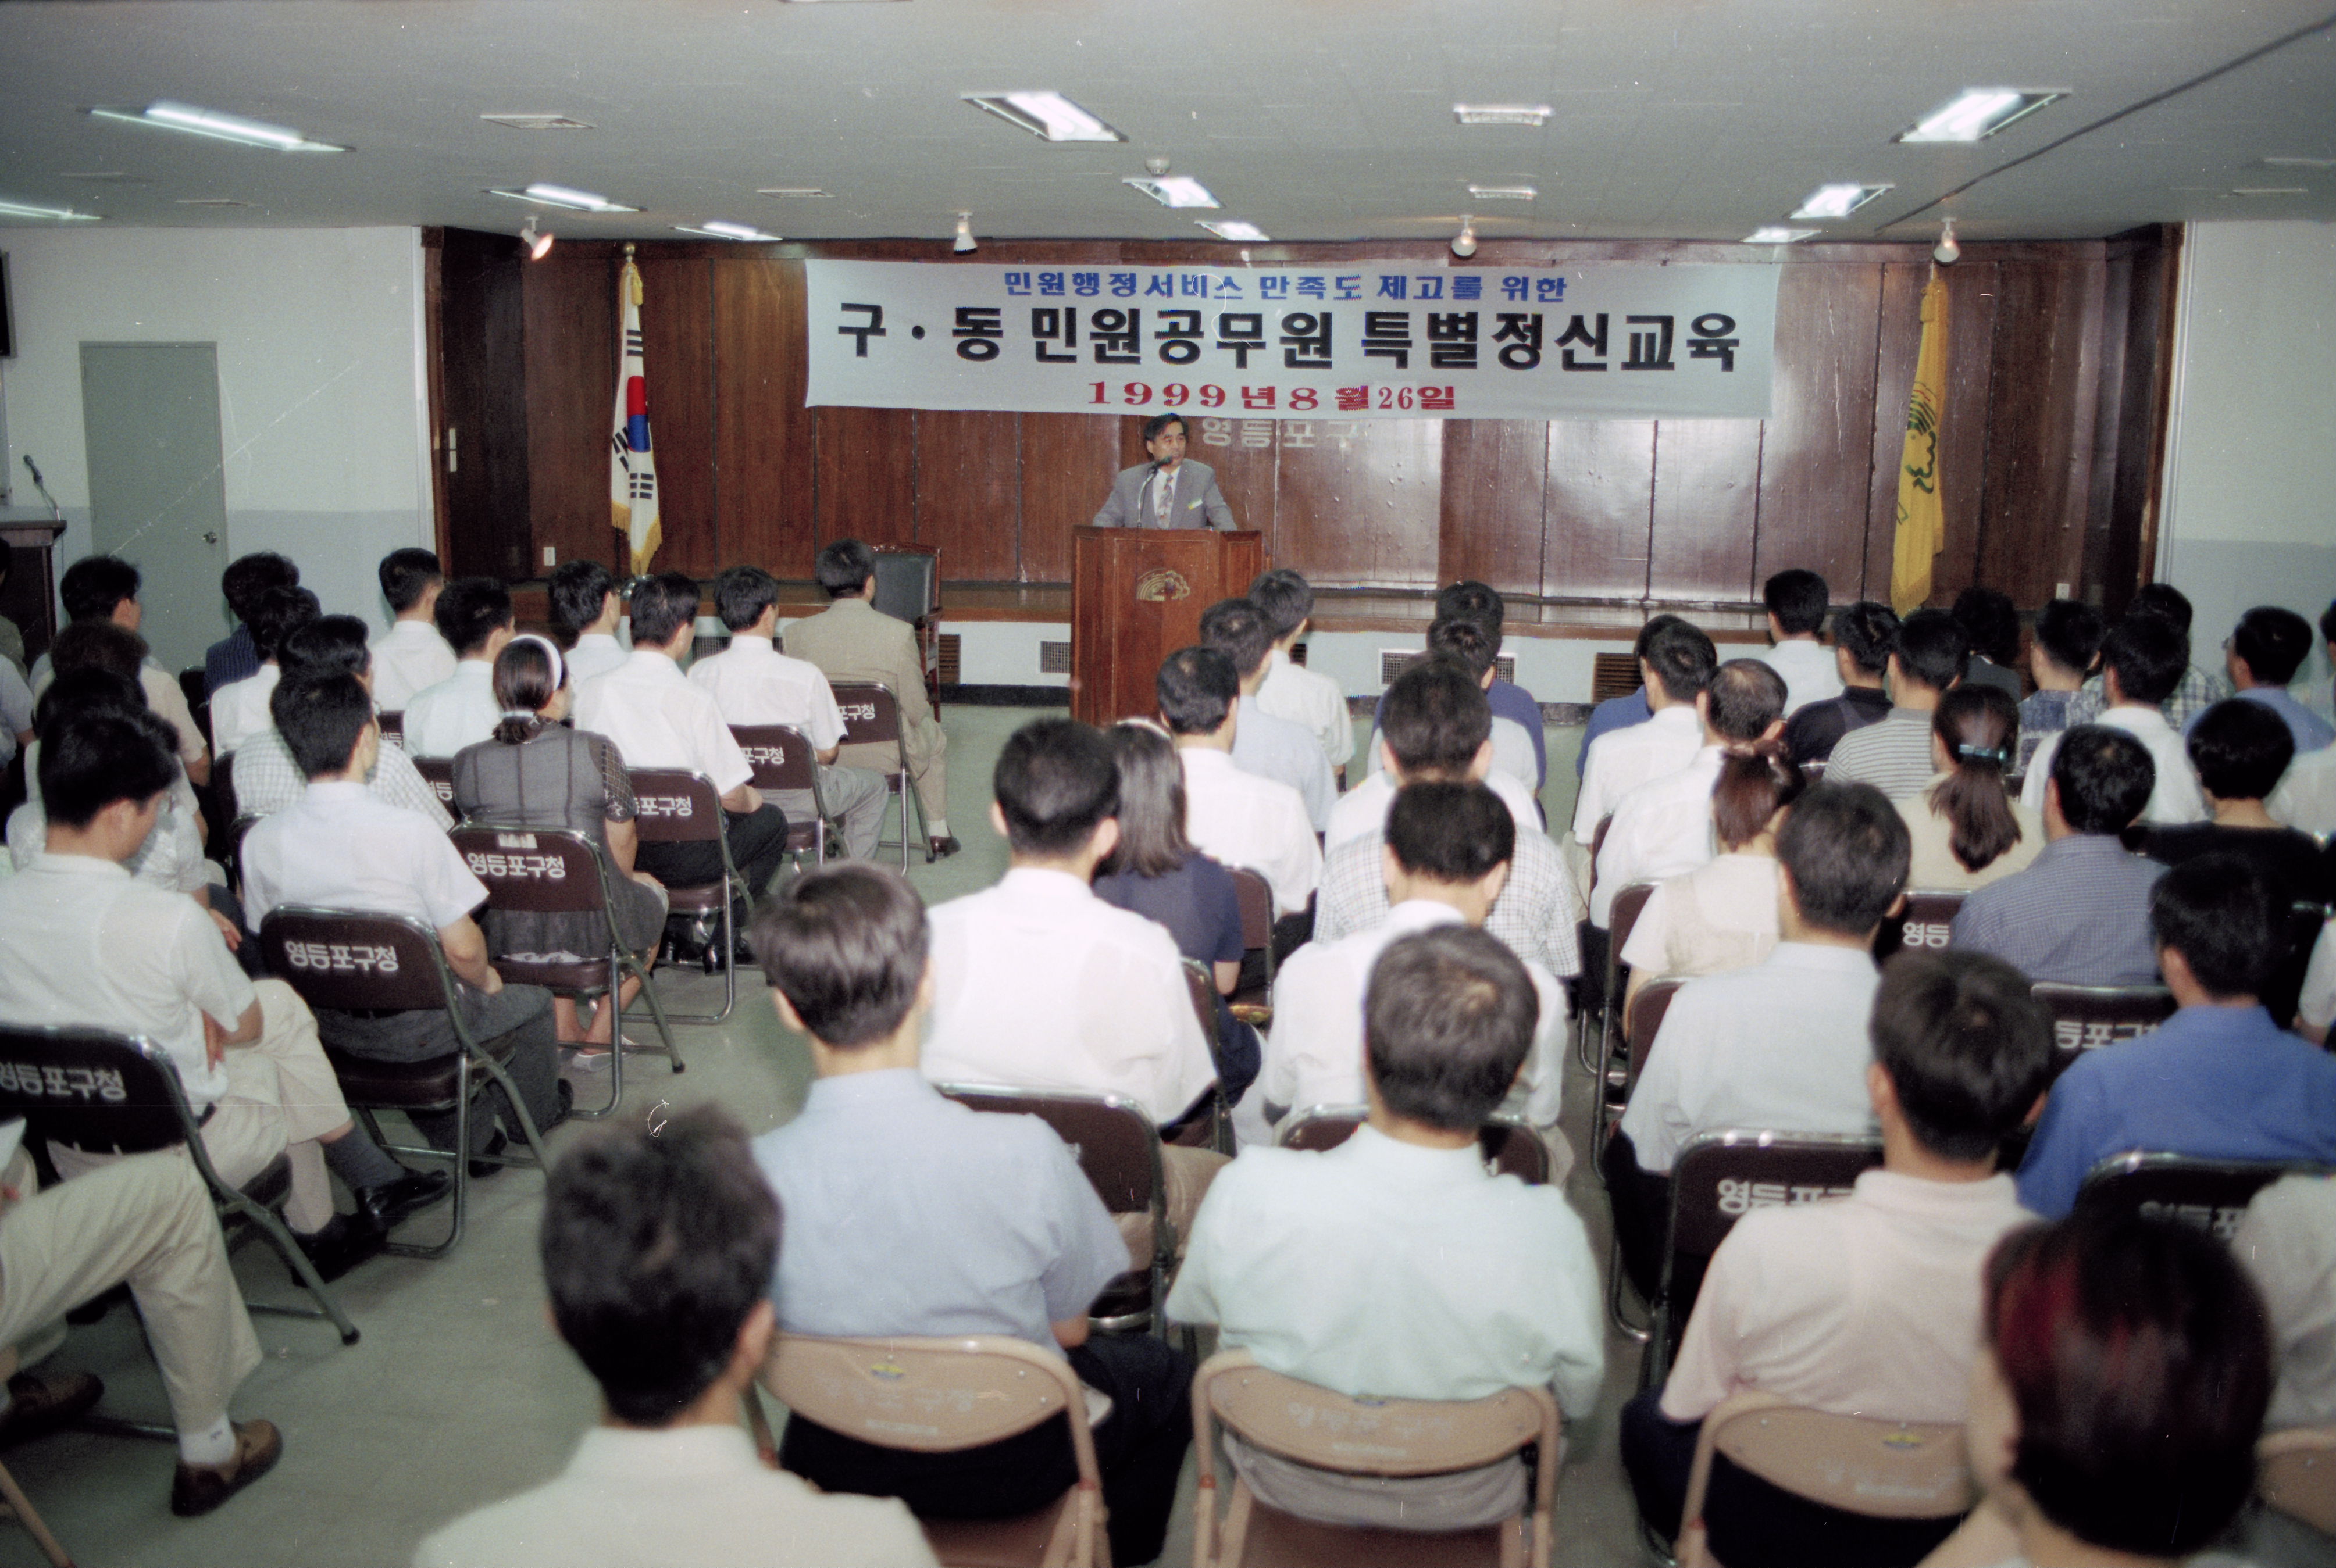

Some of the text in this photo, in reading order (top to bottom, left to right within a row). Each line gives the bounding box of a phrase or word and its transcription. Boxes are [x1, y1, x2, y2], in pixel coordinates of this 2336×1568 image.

[1004, 272, 1568, 303] 민원행정서비스 만족도 제고를 위한
[467, 852, 566, 879] 영등포구청
[285, 941, 399, 973] 영등포구청
